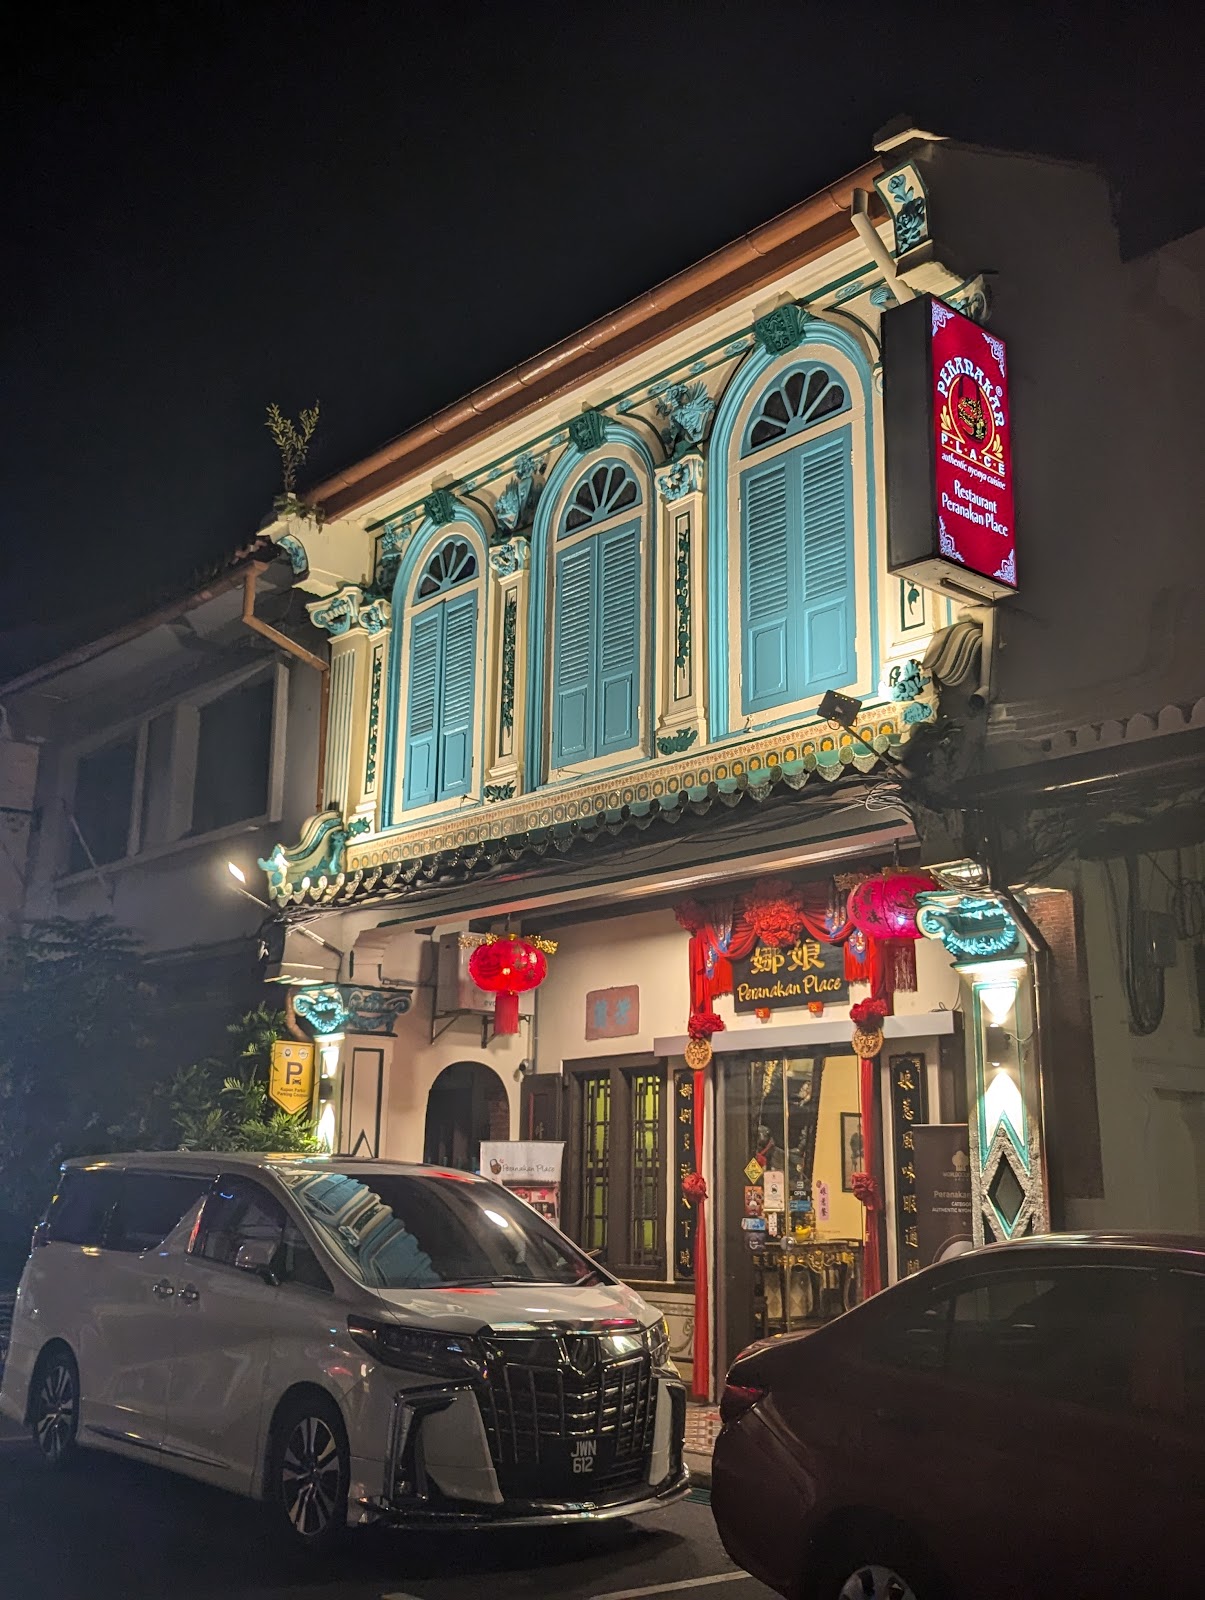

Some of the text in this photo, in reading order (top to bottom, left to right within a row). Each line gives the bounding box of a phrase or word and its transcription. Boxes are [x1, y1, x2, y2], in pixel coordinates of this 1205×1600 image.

[936, 356, 1005, 427] PERANAKAN
[941, 452, 968, 472] authentic
[986, 476, 1006, 491] cuisine
[953, 479, 998, 514] Restaurant
[941, 492, 1009, 537] Peranakan Place
[736, 974, 842, 1002] Peranakan Place
[285, 1061, 304, 1085] P
[535, 1163, 555, 1172] Place
[570, 1440, 597, 1458] JWN
[572, 1456, 594, 1474] 612
